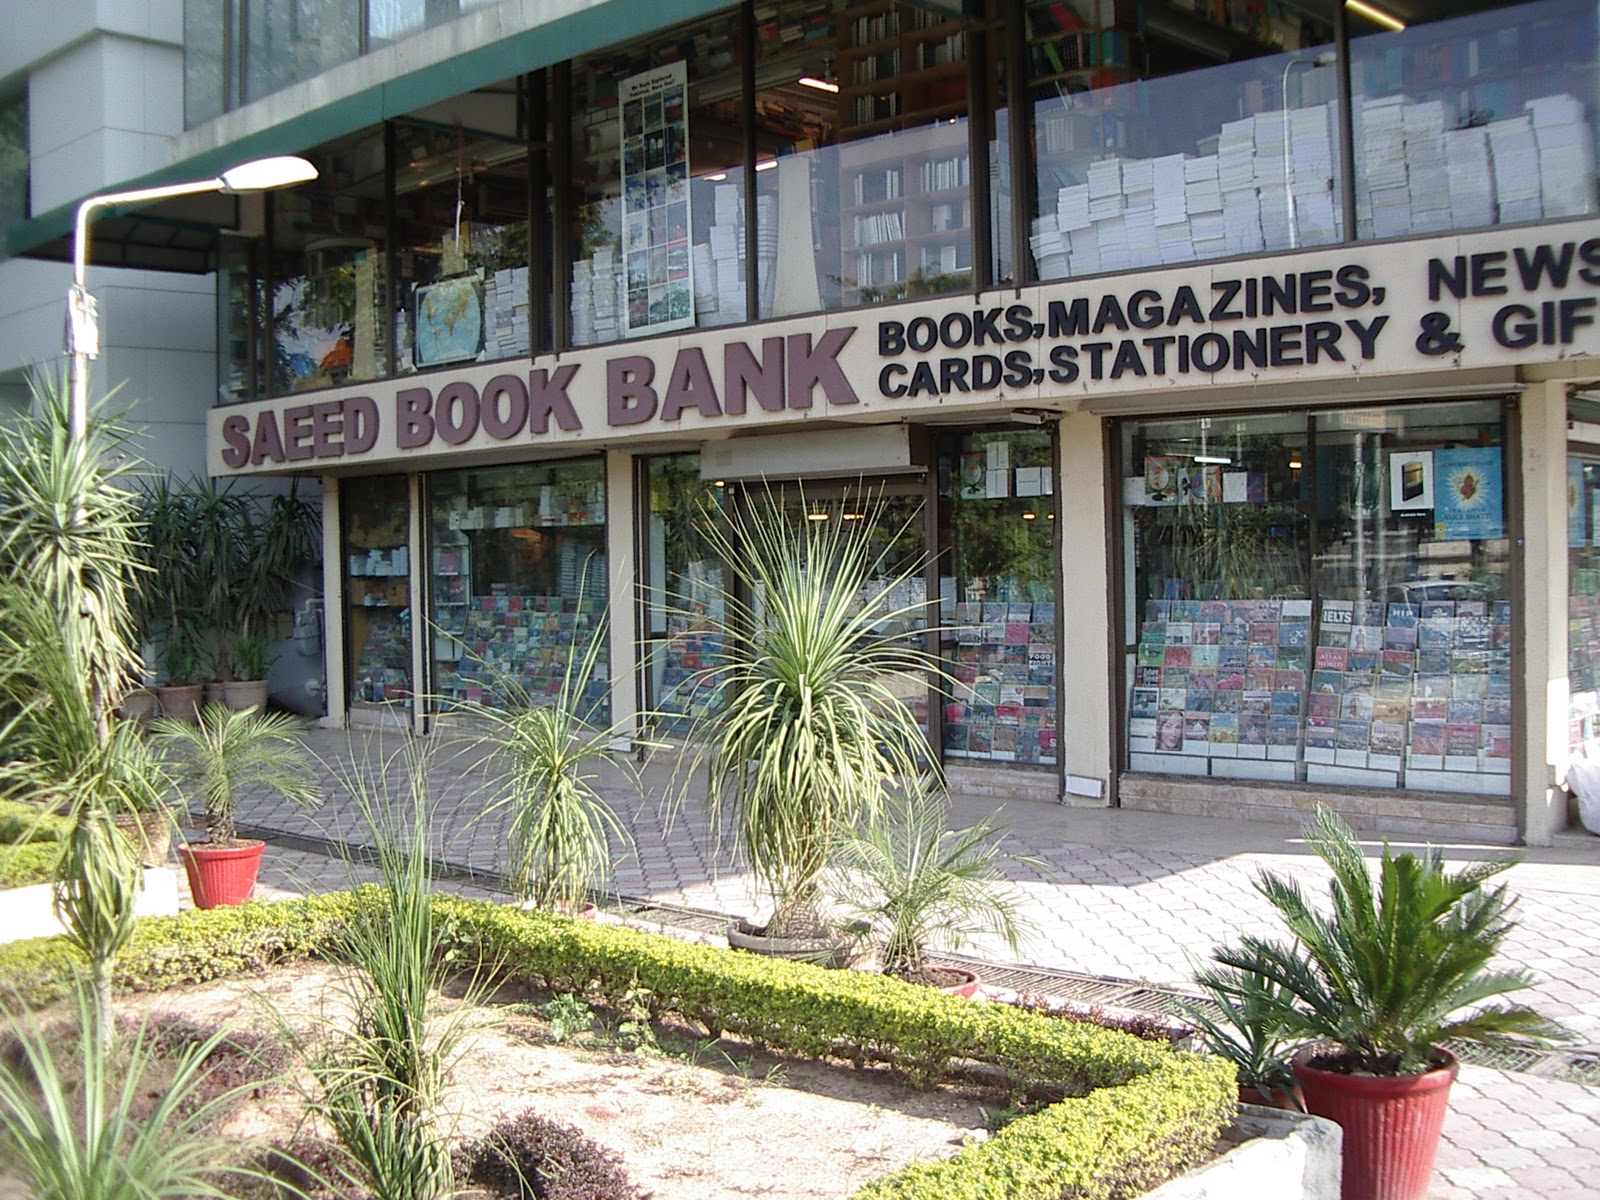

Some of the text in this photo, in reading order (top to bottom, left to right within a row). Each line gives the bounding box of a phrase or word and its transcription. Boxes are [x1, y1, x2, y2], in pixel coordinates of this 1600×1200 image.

[1416, 311, 1465, 356] &
[1492, 297, 1597, 350] GIF
[221, 326, 859, 468] SAEED BOOK BANK
[1323, 610, 1352, 624] IELTS
